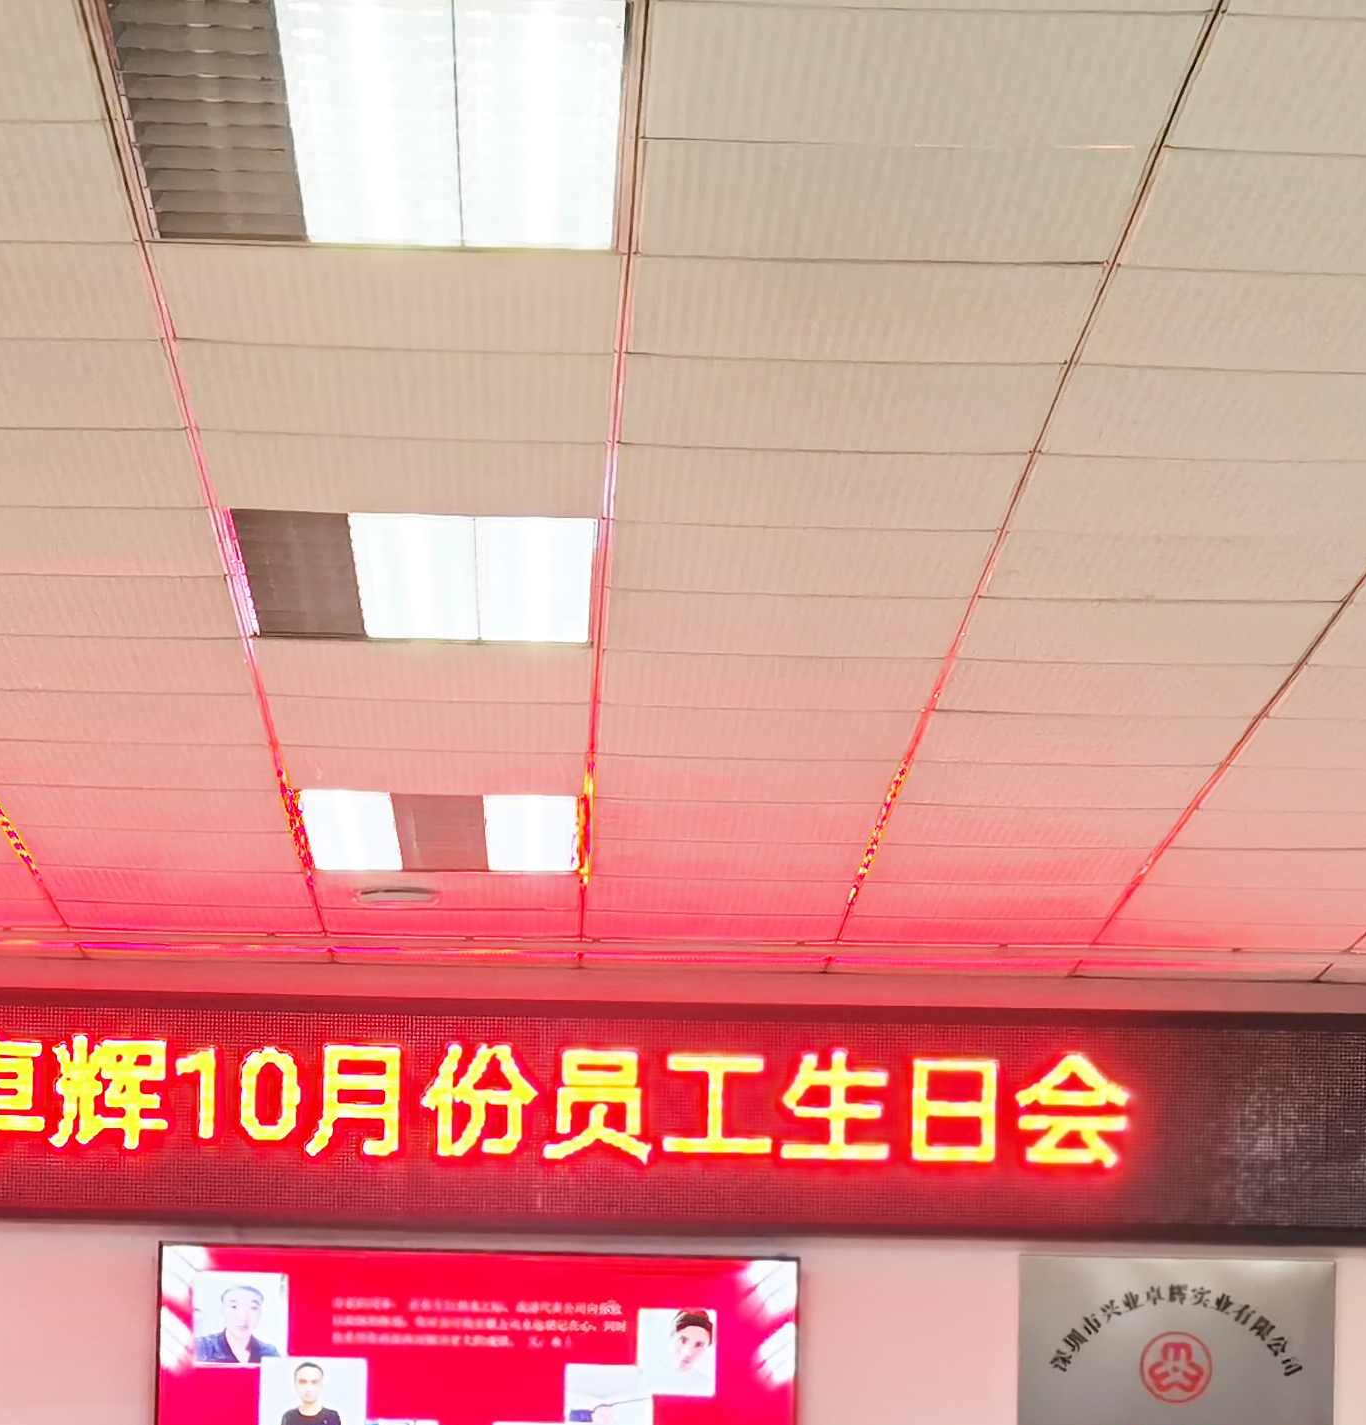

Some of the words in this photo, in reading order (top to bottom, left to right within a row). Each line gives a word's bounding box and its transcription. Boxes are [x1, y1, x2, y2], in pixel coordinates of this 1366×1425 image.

[1049, 1284, 1303, 1377] 深圳市兴业卓辉实业有限公司
